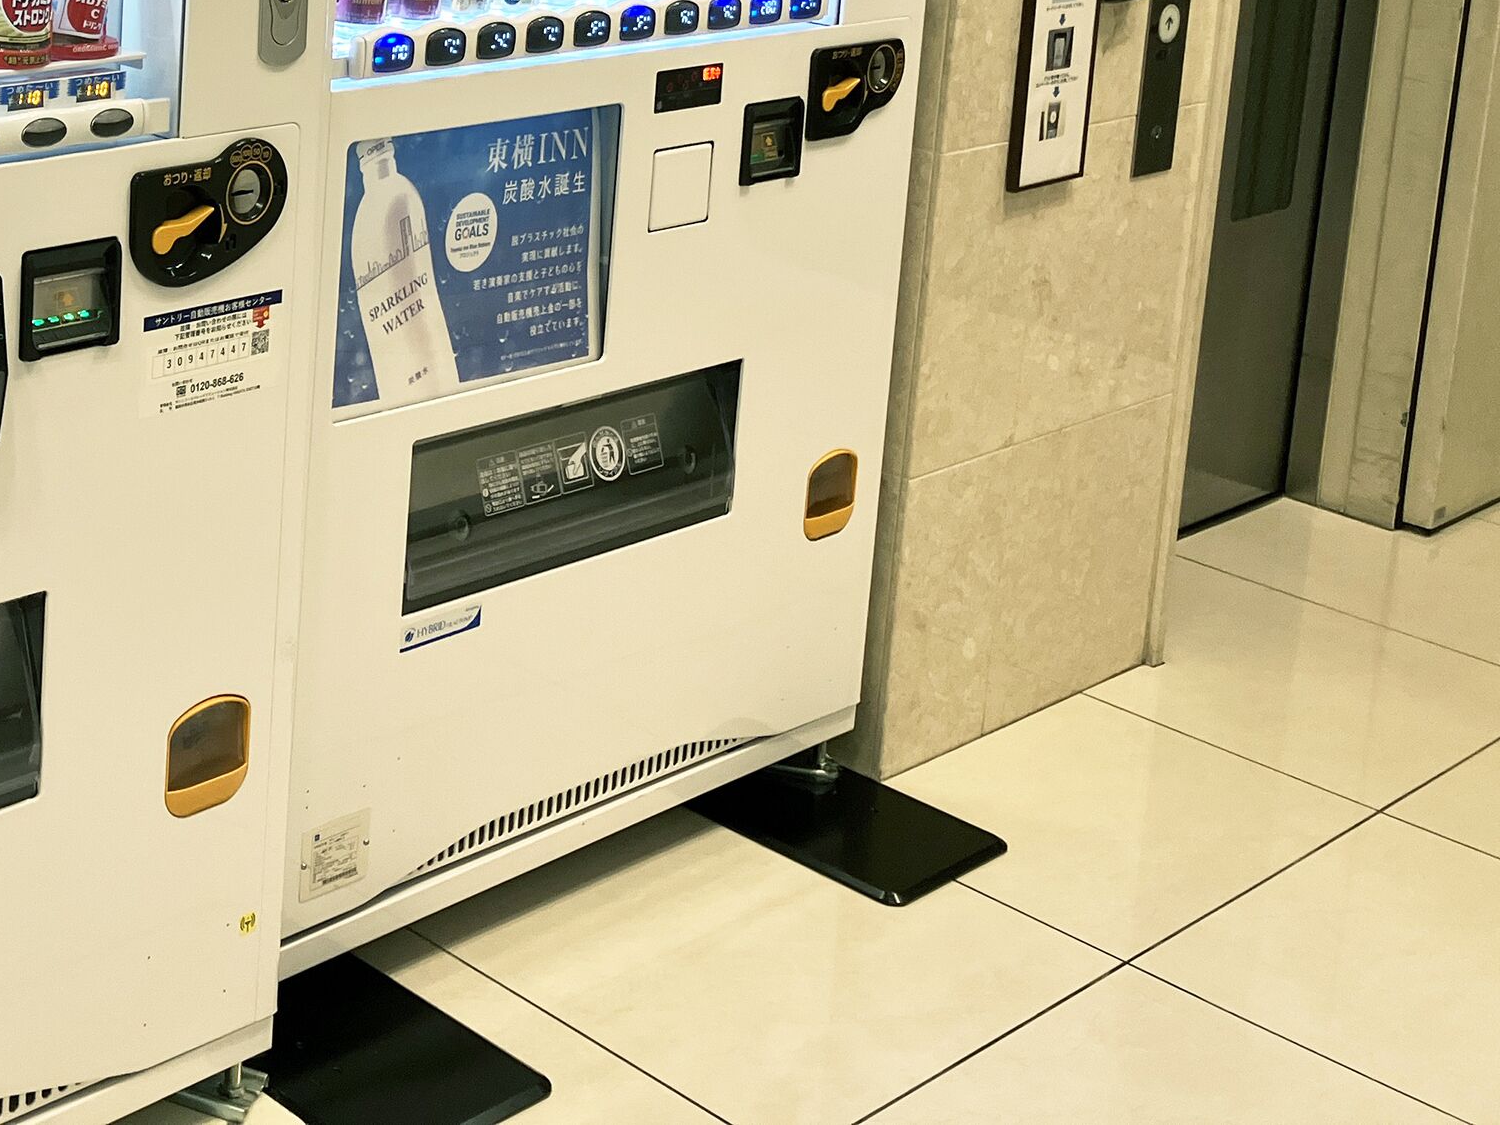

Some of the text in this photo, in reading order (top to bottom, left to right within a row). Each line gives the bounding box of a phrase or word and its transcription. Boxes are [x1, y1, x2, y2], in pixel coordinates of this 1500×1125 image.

[90, 9, 100, 20] C
[485, 126, 590, 174] 東横INN
[163, 167, 212, 187] おつり・返却
[501, 170, 587, 205] 炭酸水誕生
[455, 216, 490, 228] DEVELOPMENT
[456, 208, 491, 220] SUSTAINABLE
[454, 223, 489, 241] GOALS
[511, 224, 584, 247] 脱プラスチック社会の
[368, 272, 429, 323] SPARKLING
[382, 298, 426, 336] WATER
[190, 372, 245, 393] 0120-868-626
